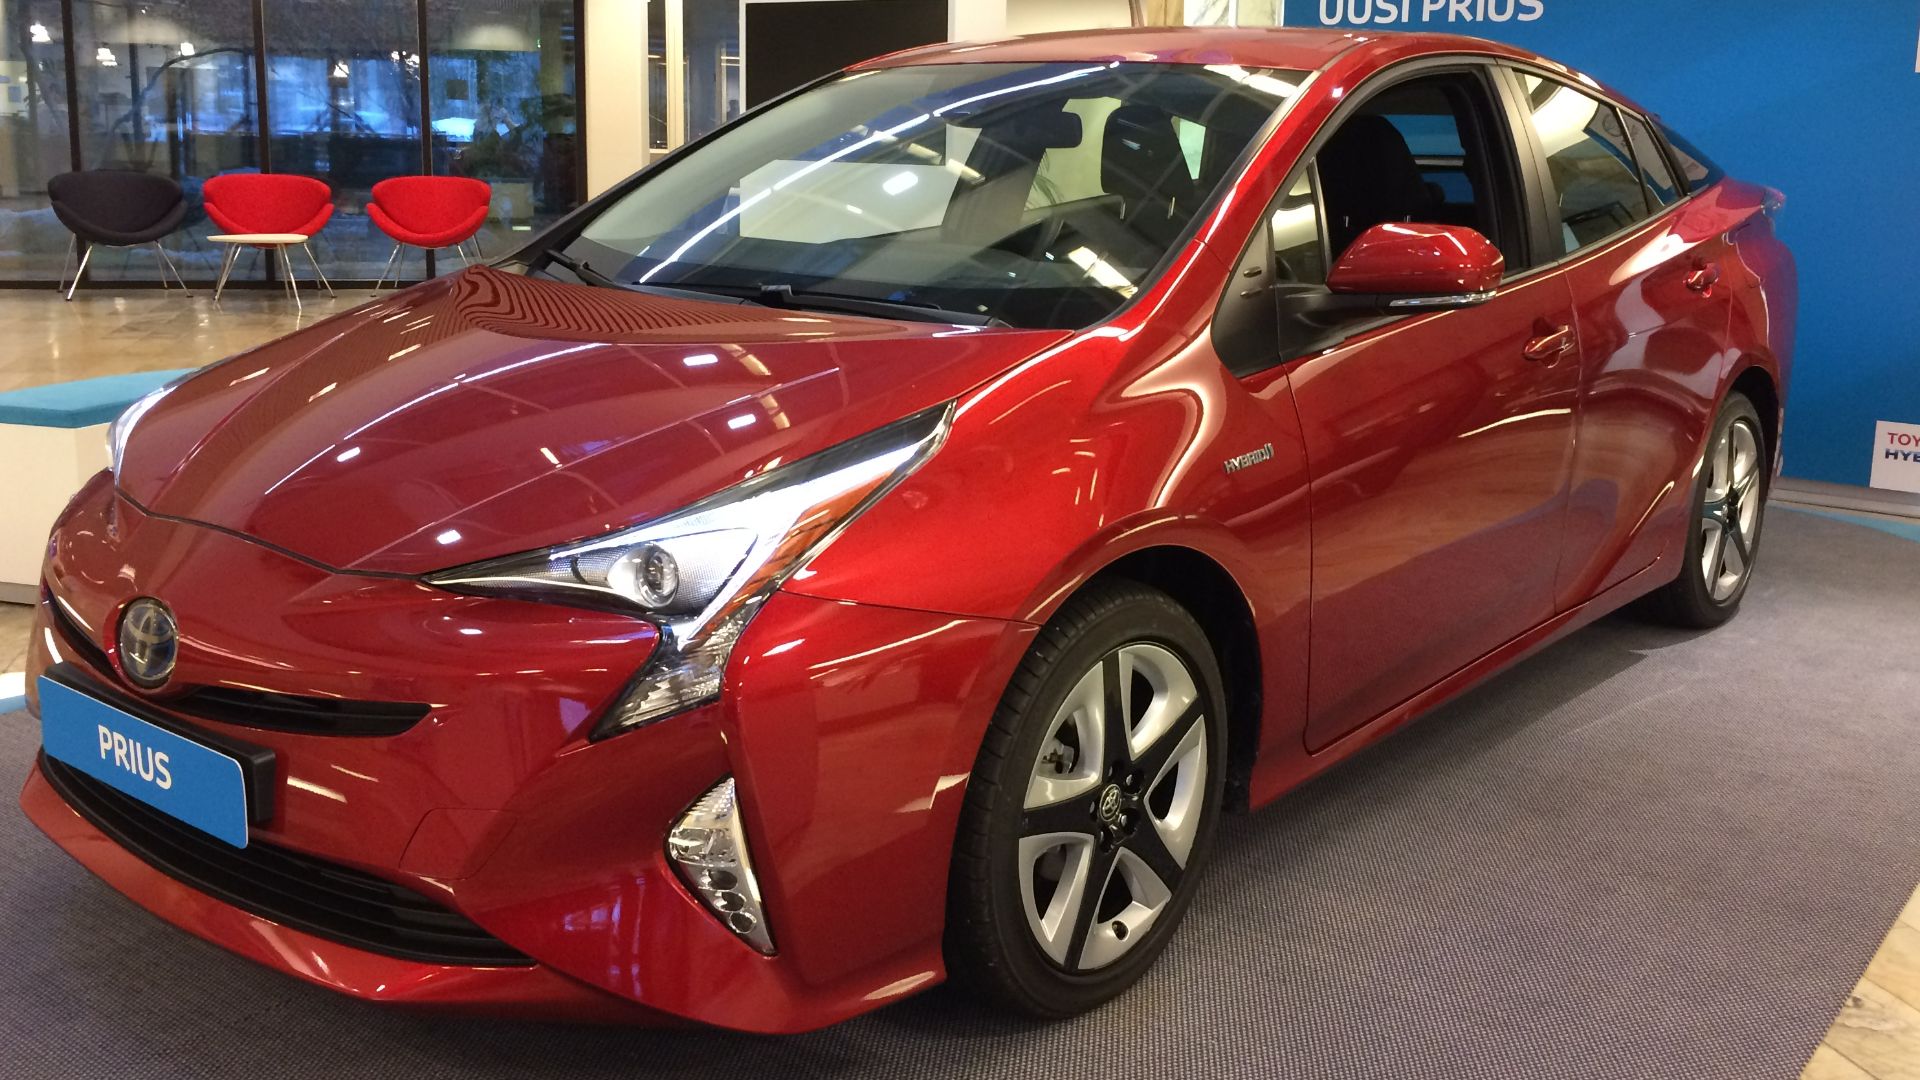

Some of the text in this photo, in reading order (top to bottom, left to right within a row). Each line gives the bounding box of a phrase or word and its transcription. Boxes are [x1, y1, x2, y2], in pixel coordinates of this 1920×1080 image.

[1319, 0, 1544, 25] UUSI PRIUS
[1223, 447, 1267, 475] HYBRID
[98, 724, 172, 790] PRIUS
